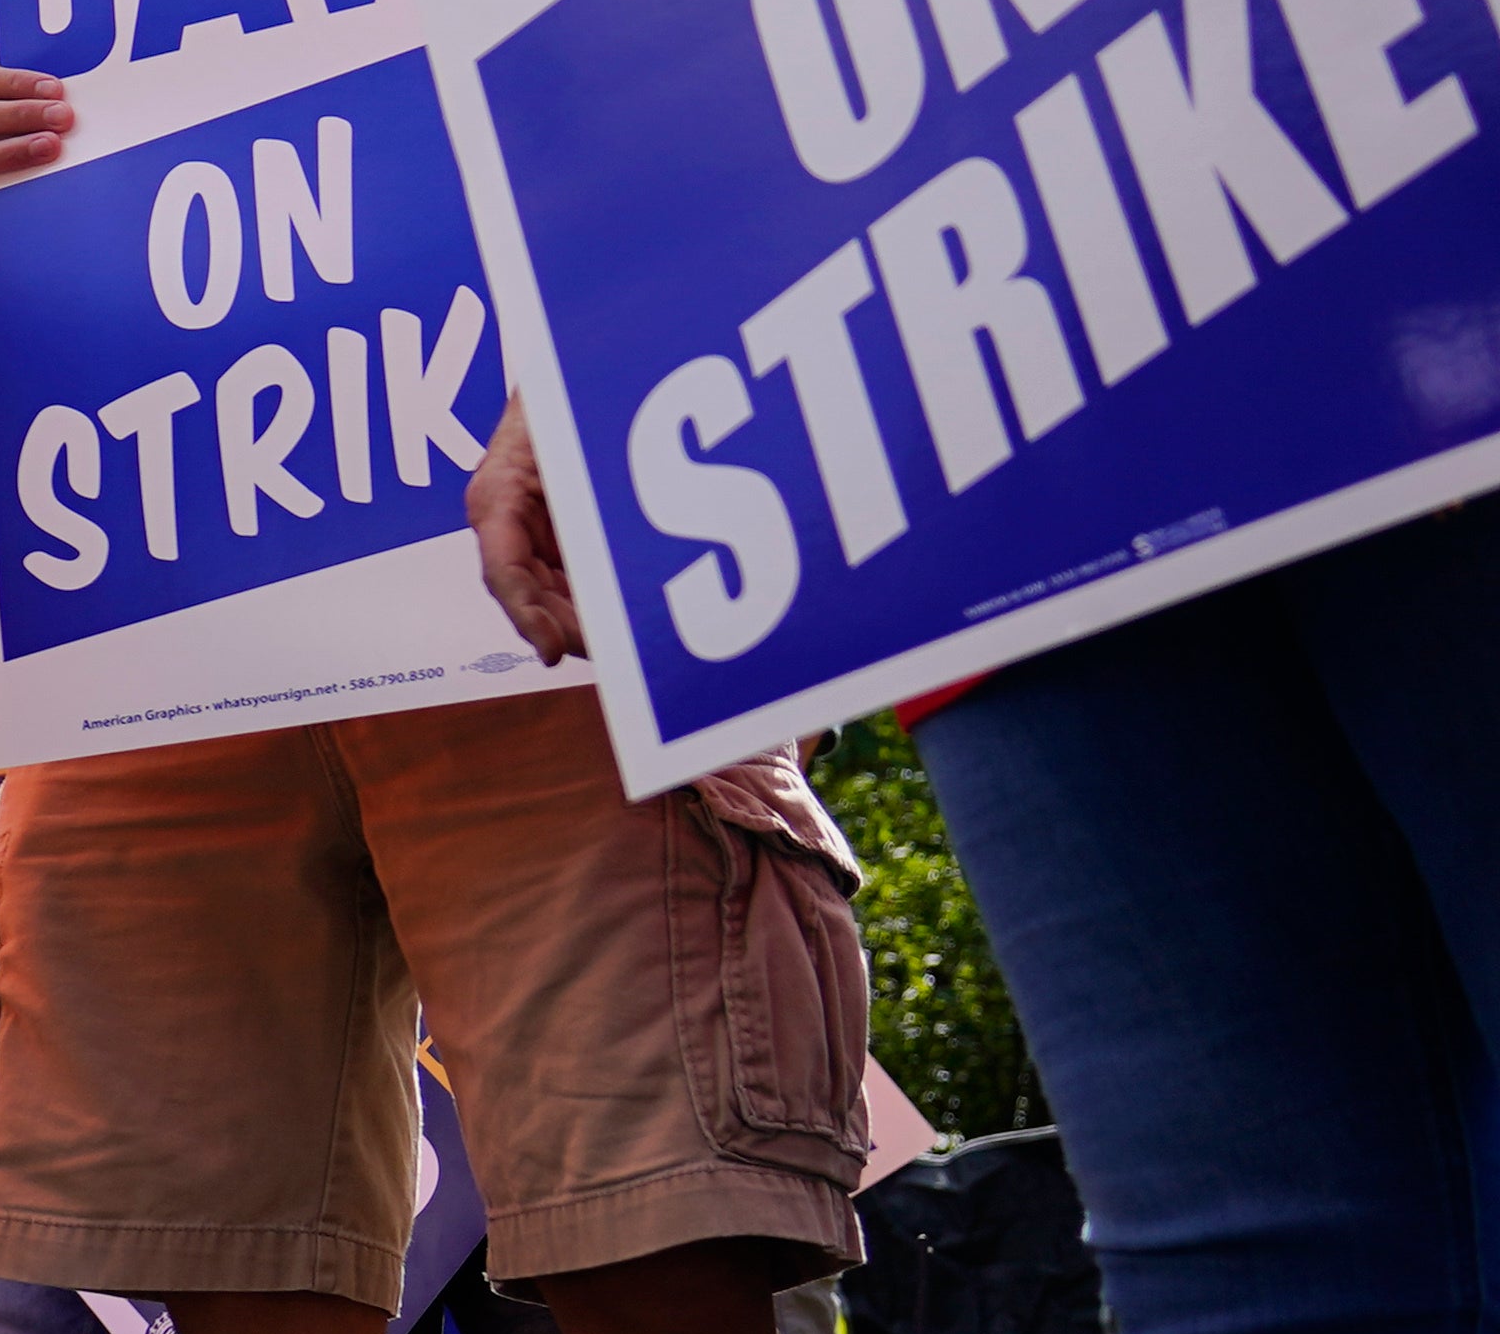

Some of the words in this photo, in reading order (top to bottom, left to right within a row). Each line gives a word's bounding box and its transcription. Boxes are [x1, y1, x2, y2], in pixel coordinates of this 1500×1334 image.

[148, 116, 353, 330] ON
[18, 285, 488, 591] STRIK
[82, 712, 142, 731] American
[145, 702, 203, 725] Graphics
[212, 681, 339, 714] whatsyoursign.net
[348, 666, 445, 691] 586.790.8500
